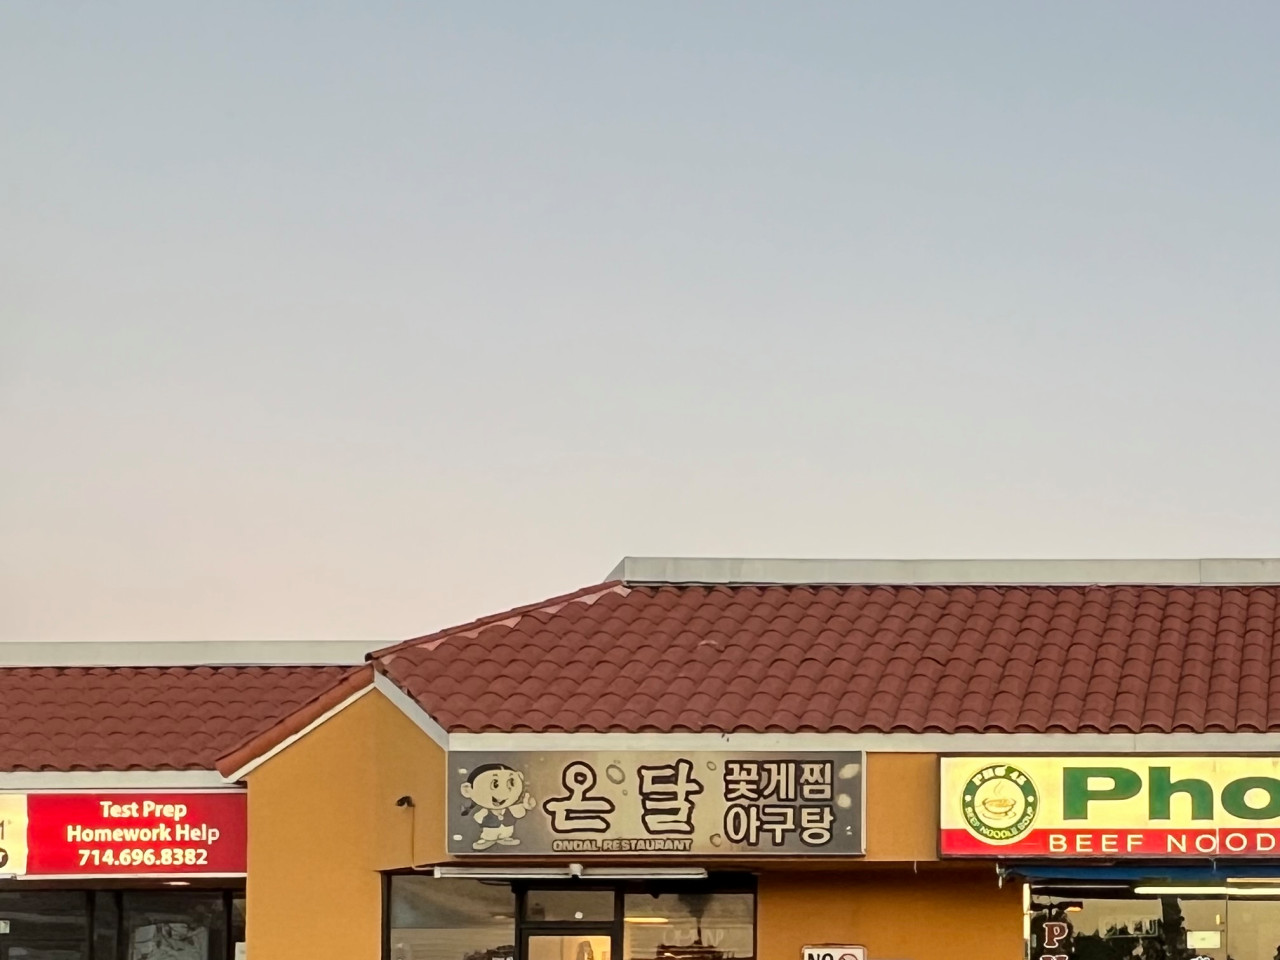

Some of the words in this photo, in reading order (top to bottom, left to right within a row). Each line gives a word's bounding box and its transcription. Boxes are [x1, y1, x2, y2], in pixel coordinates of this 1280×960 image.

[724, 760, 834, 801] 꽃게찜
[100, 801, 139, 818] Test
[143, 801, 187, 821] Prep
[66, 824, 172, 842] Homework
[175, 824, 220, 844] Help
[724, 804, 836, 846] 아구탕
[602, 838, 693, 851] RESTAURANT
[1048, 834, 1143, 853] BEEF
[78, 849, 208, 866] 714.696.8382
